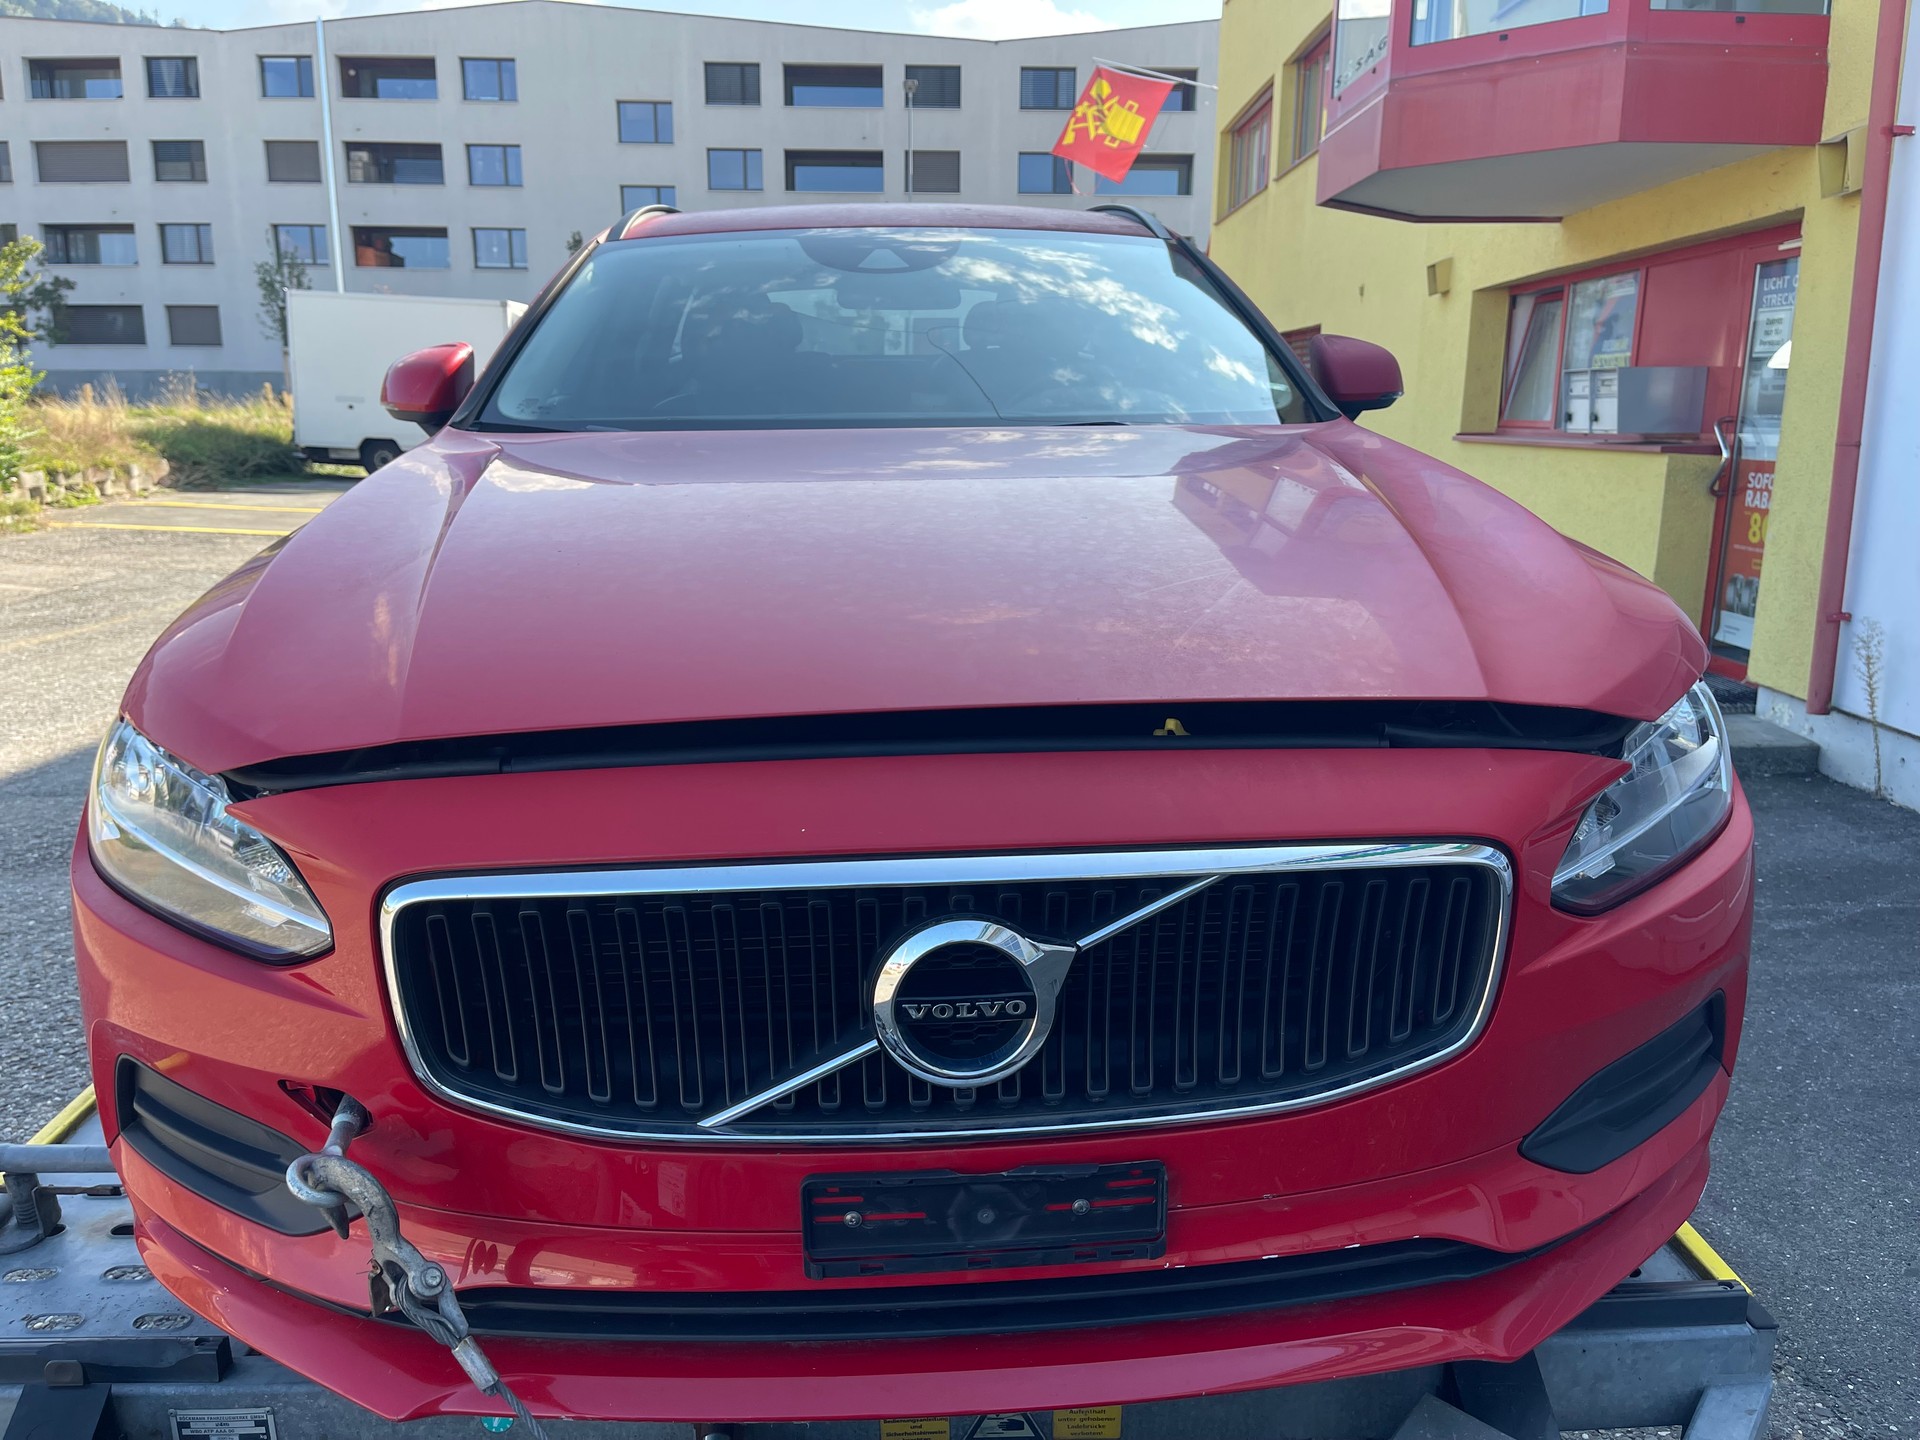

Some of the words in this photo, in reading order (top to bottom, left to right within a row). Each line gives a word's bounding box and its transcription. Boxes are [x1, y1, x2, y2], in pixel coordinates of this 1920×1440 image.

[1763, 275, 1790, 291] LICHT
[1745, 489, 1770, 509] RAB
[901, 1000, 1026, 1019] VOLVO
